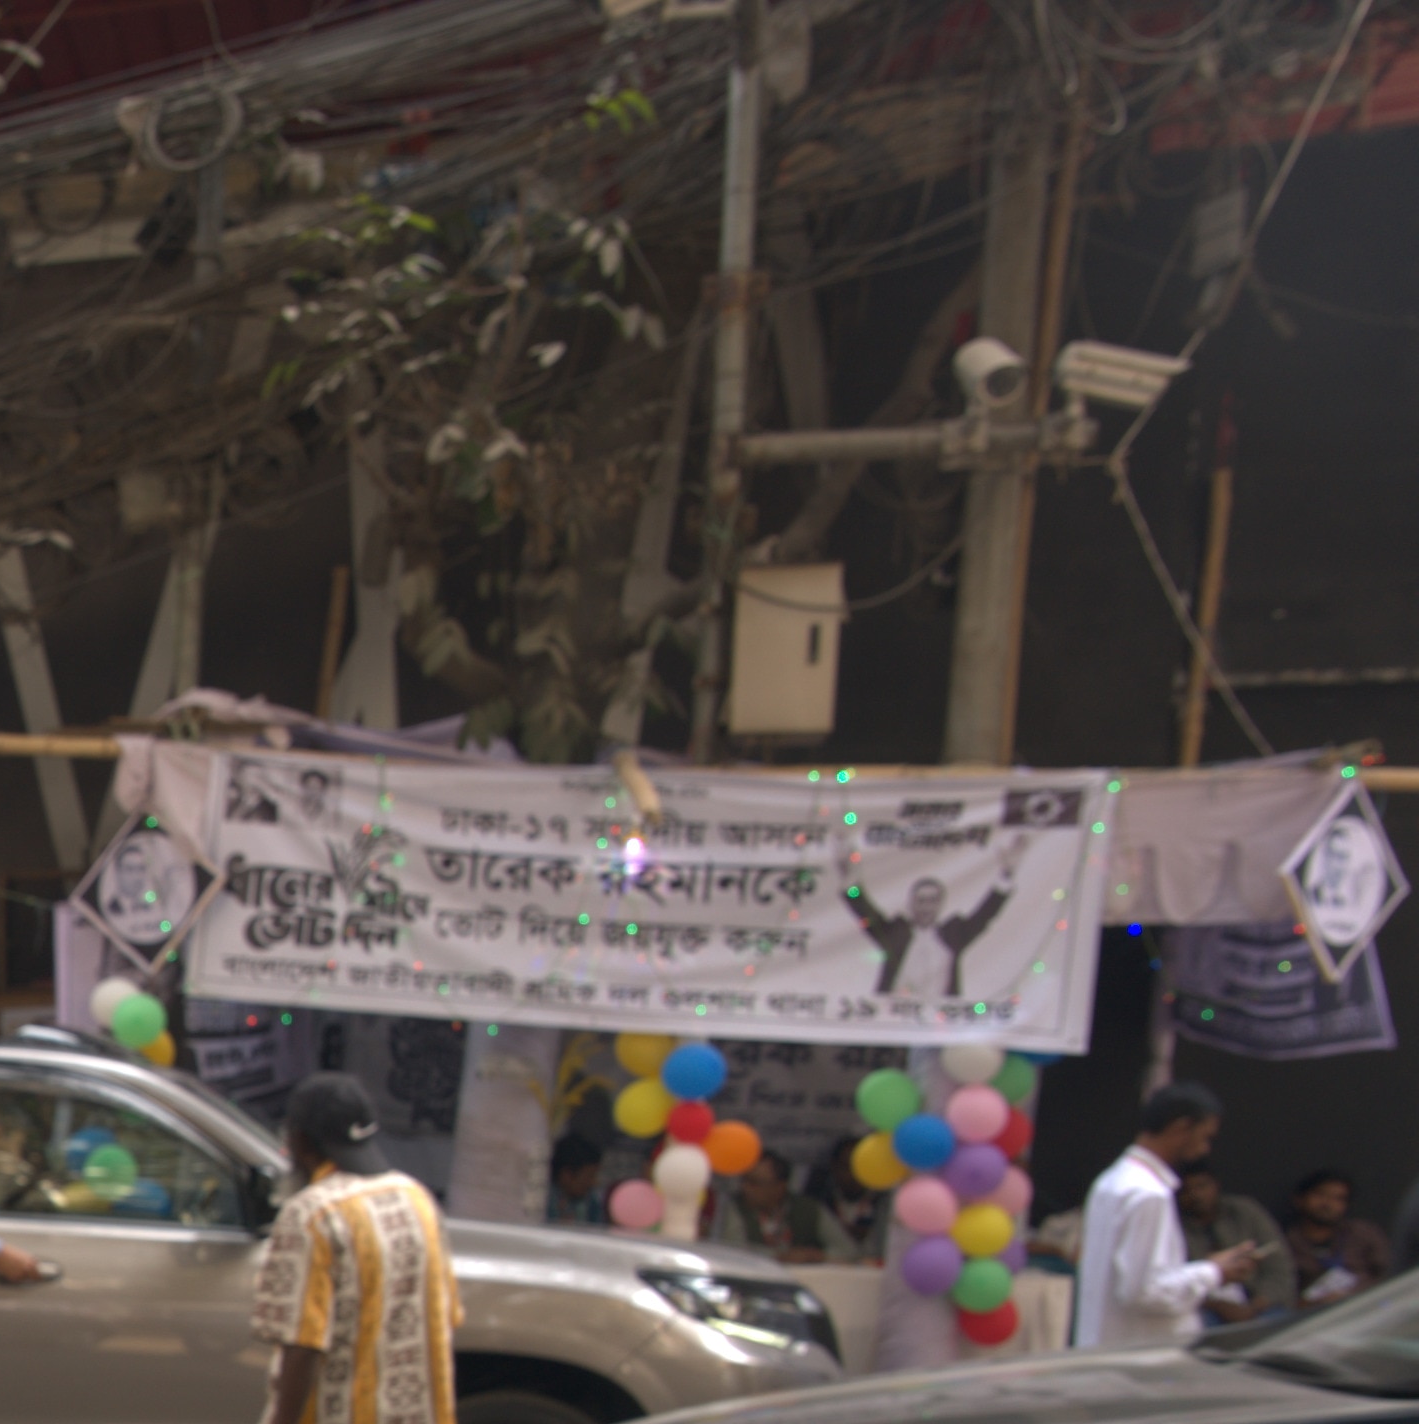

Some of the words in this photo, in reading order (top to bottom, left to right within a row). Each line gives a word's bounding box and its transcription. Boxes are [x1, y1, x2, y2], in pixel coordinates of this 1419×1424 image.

[224, 855, 336, 911] ধানের
[426, 845, 581, 893] তারেক
[596, 856, 824, 907] রহমানকে
[246, 907, 337, 951] ভোট
[342, 909, 399, 953] দিন
[435, 905, 508, 940] ভোট
[518, 906, 590, 946] দিয়ে
